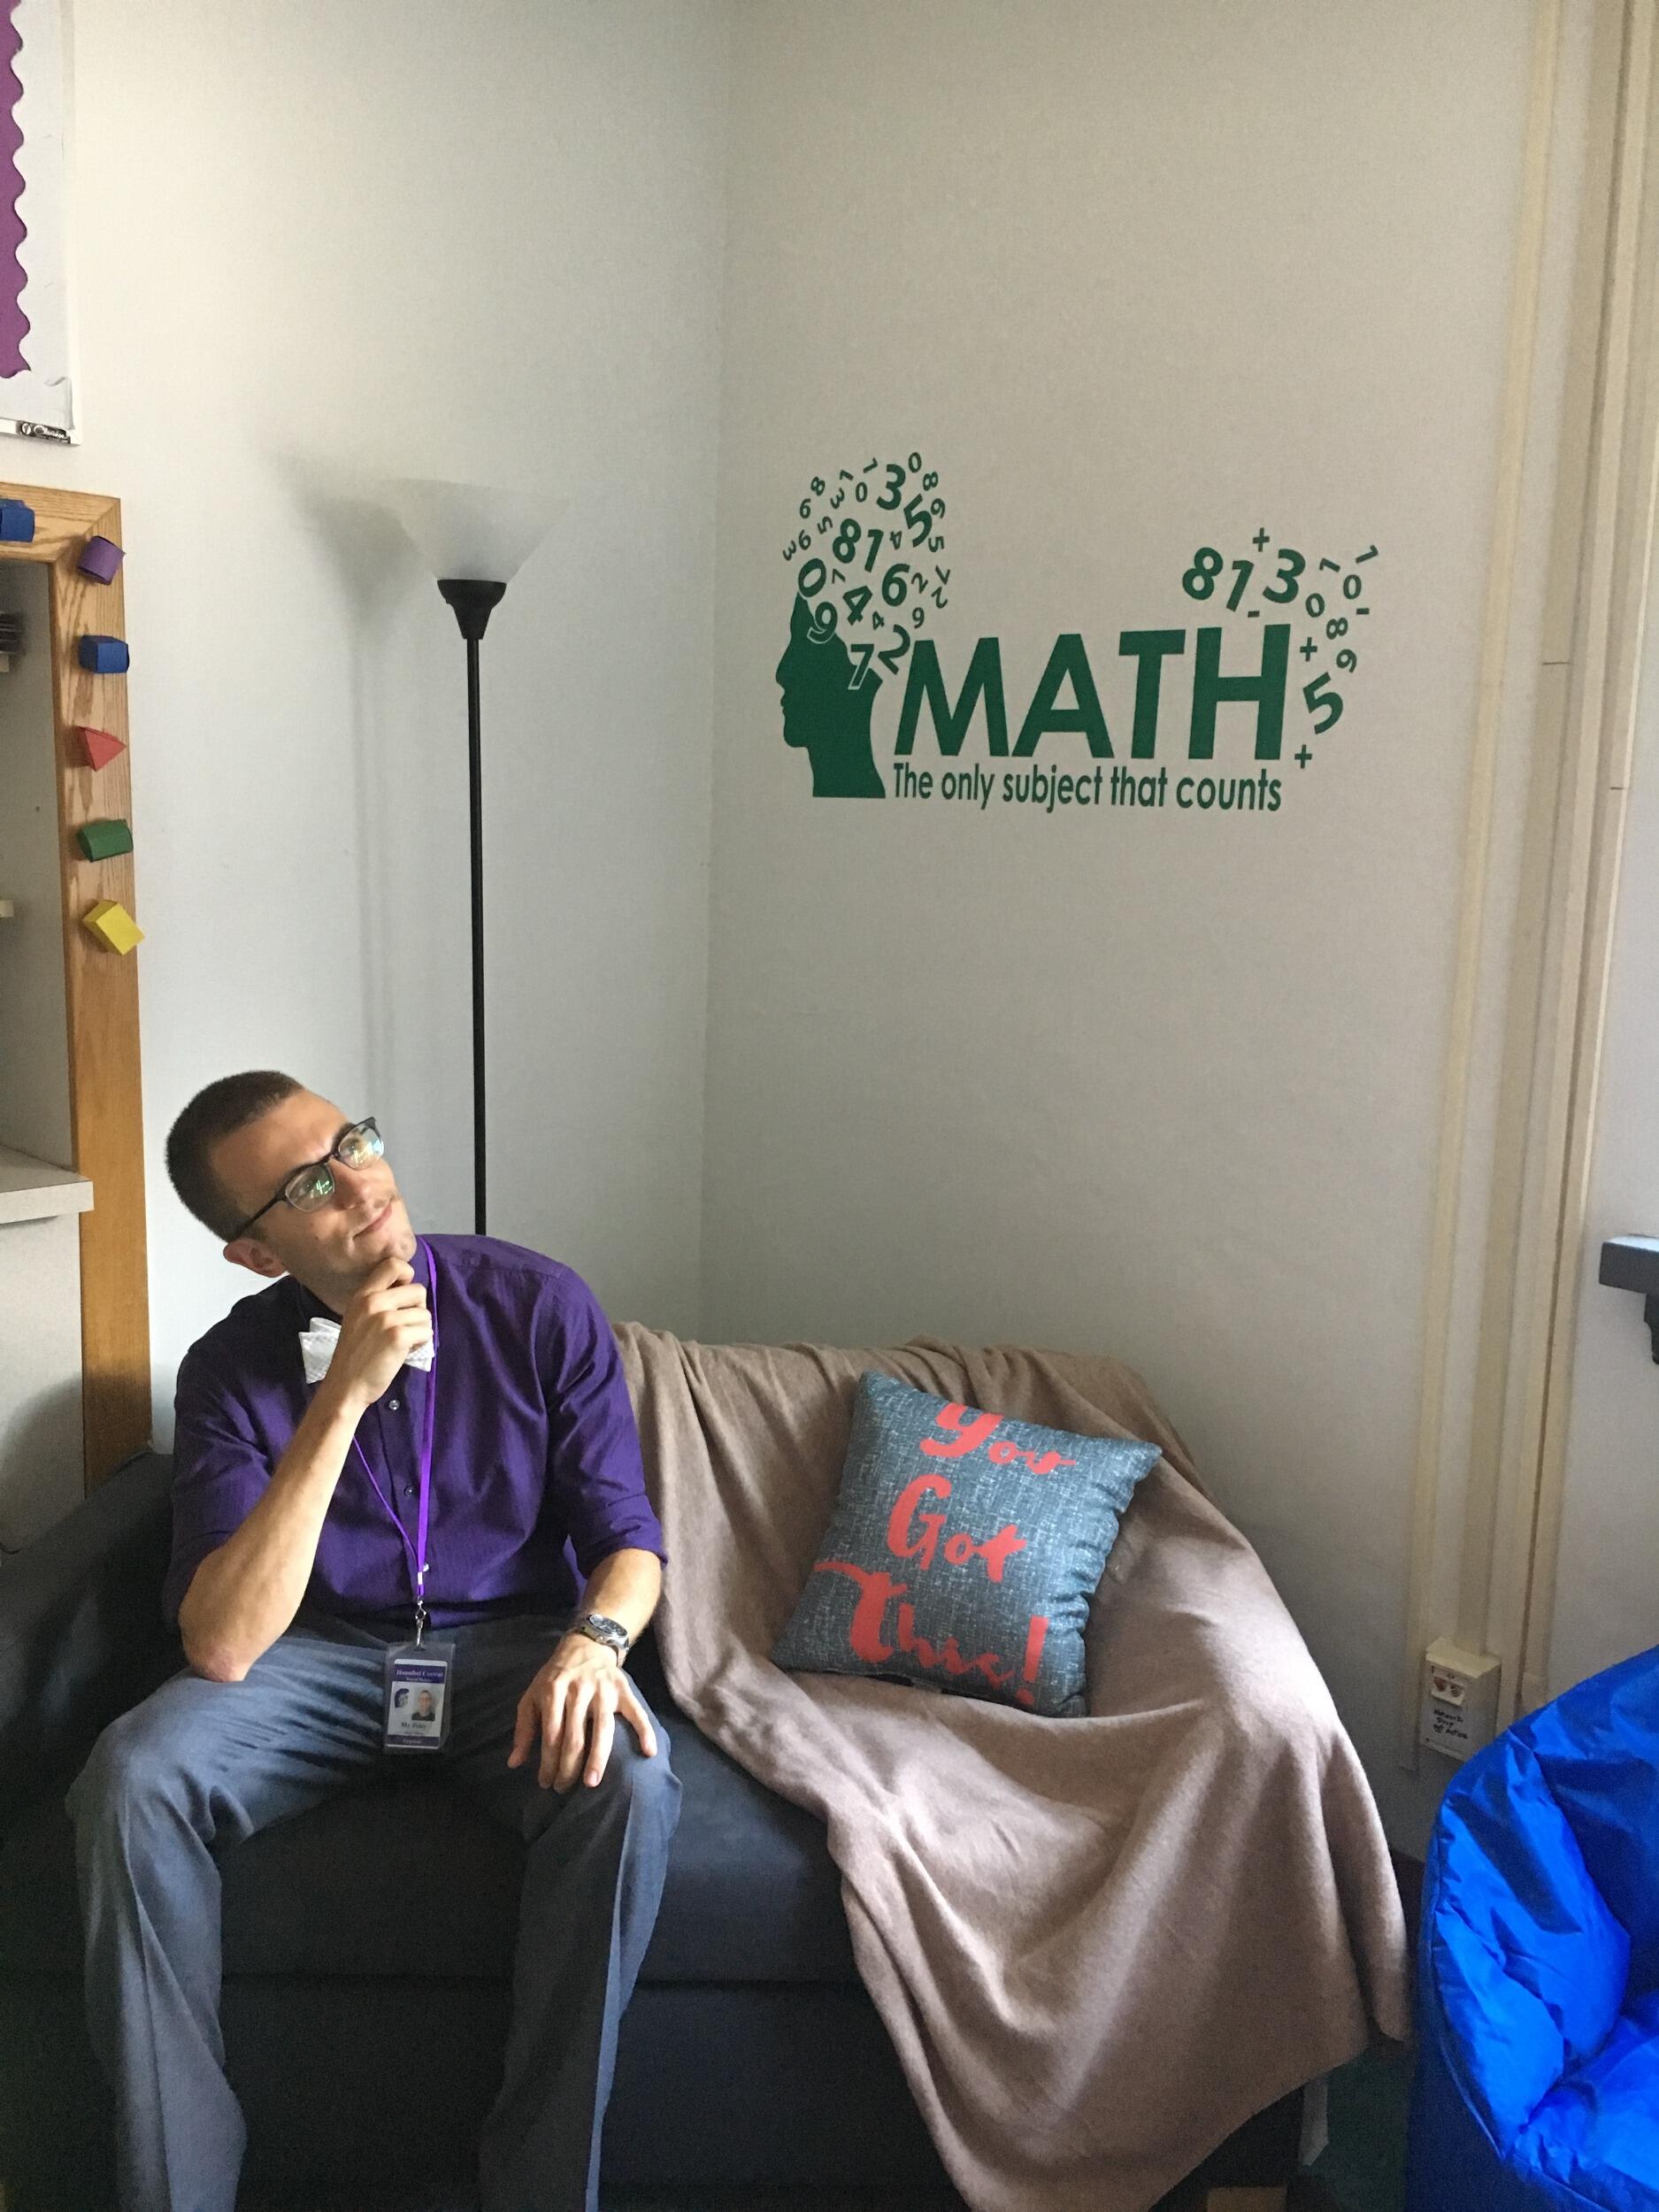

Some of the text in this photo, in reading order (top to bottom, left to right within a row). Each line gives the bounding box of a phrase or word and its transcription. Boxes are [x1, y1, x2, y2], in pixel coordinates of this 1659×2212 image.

[810, 476, 826, 496] 8
[830, 487, 845, 510] 3
[876, 463, 907, 511] 3
[923, 471, 939, 491] 8
[799, 498, 811, 519] 6
[902, 493, 933, 549] 5
[782, 540, 797, 562] 3
[889, 531, 902, 550] 4
[928, 535, 945, 553] 5
[882, 563, 911, 607] 6
[1262, 549, 1306, 603] 3
[807, 602, 838, 644] 9
[842, 585, 873, 626] 4
[872, 611, 885, 630] 4
[878, 624, 910, 676] 2
[1326, 617, 1348, 641] 8
[848, 643, 876, 690] 7
[894, 623, 1291, 761] MATH
[1303, 672, 1344, 735] 5
[893, 762, 1282, 814] The only subject that counts
[919, 1402, 1077, 1475] You
[887, 1474, 1028, 1584] Got
[812, 1561, 1050, 1707] This!
